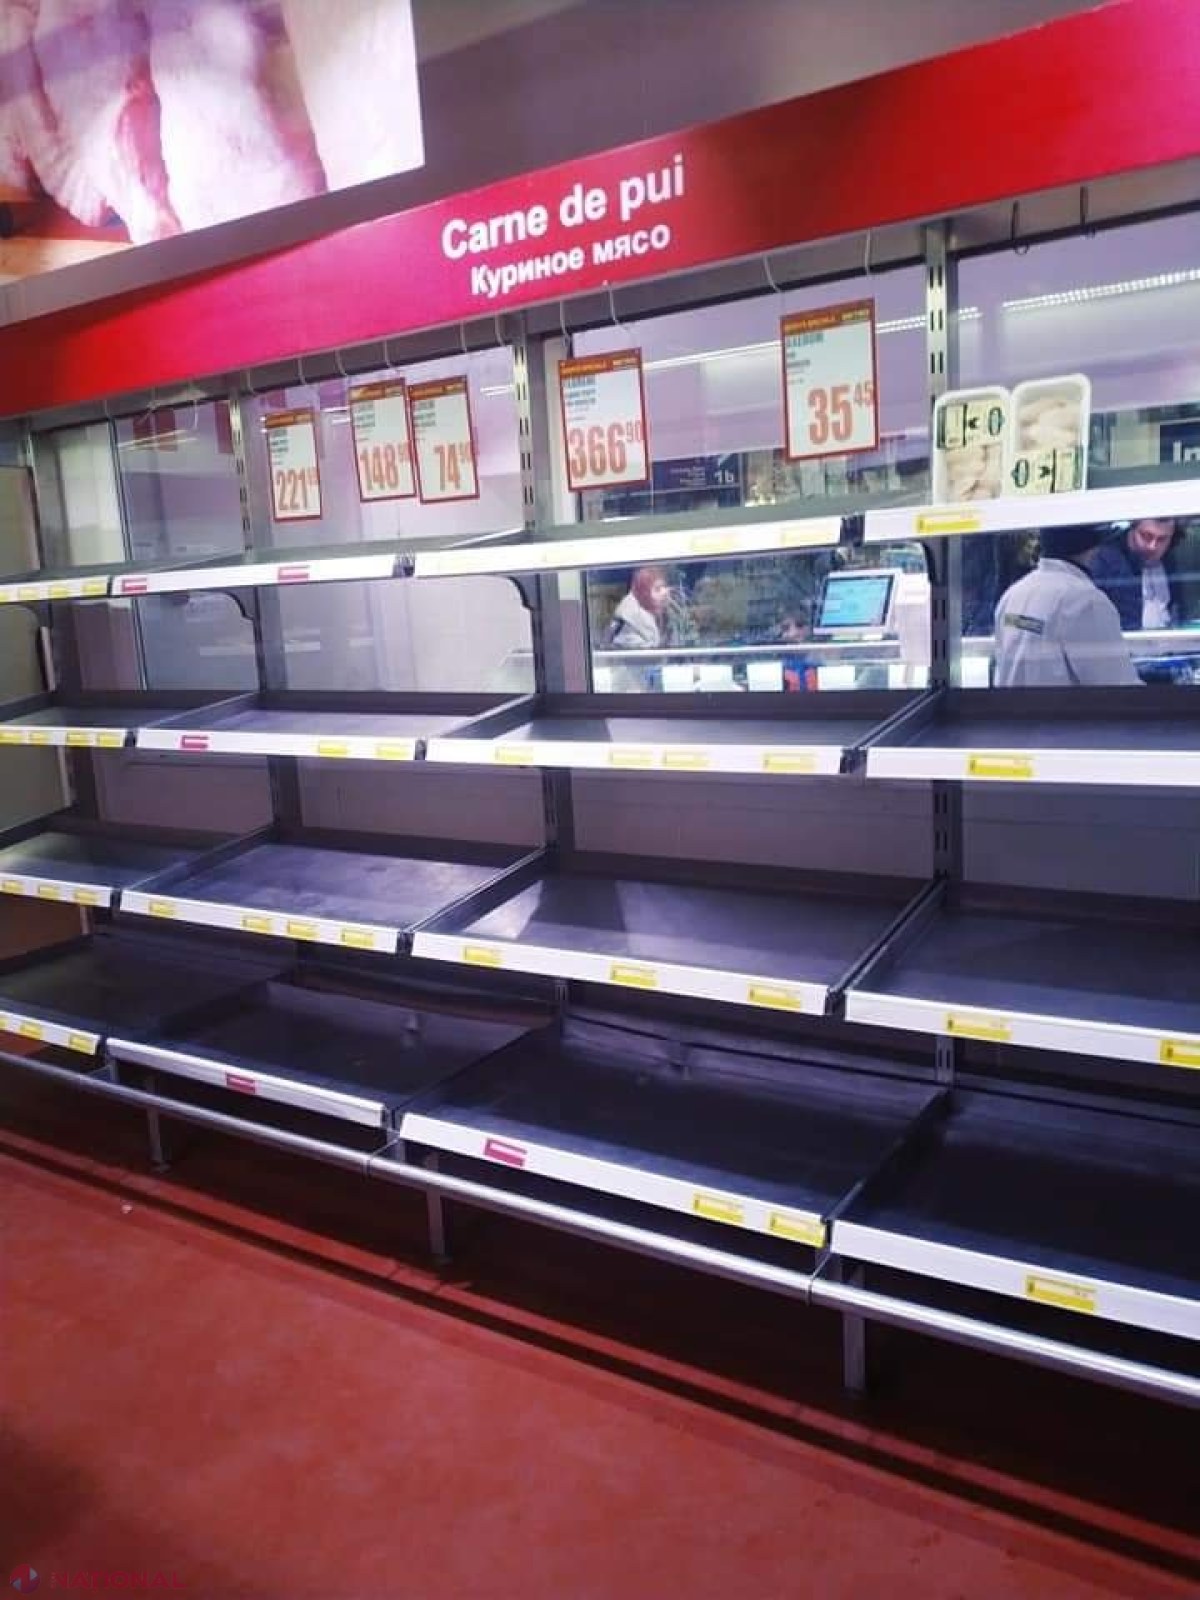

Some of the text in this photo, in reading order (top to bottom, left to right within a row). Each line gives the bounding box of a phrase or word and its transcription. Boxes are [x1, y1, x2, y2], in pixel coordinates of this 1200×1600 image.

[441, 153, 685, 259] Carne de pui
[470, 224, 671, 298] Куриное мясо
[806, 385, 854, 446] 35
[359, 443, 400, 491] 148
[569, 422, 628, 479] 366
[276, 468, 308, 511] 221
